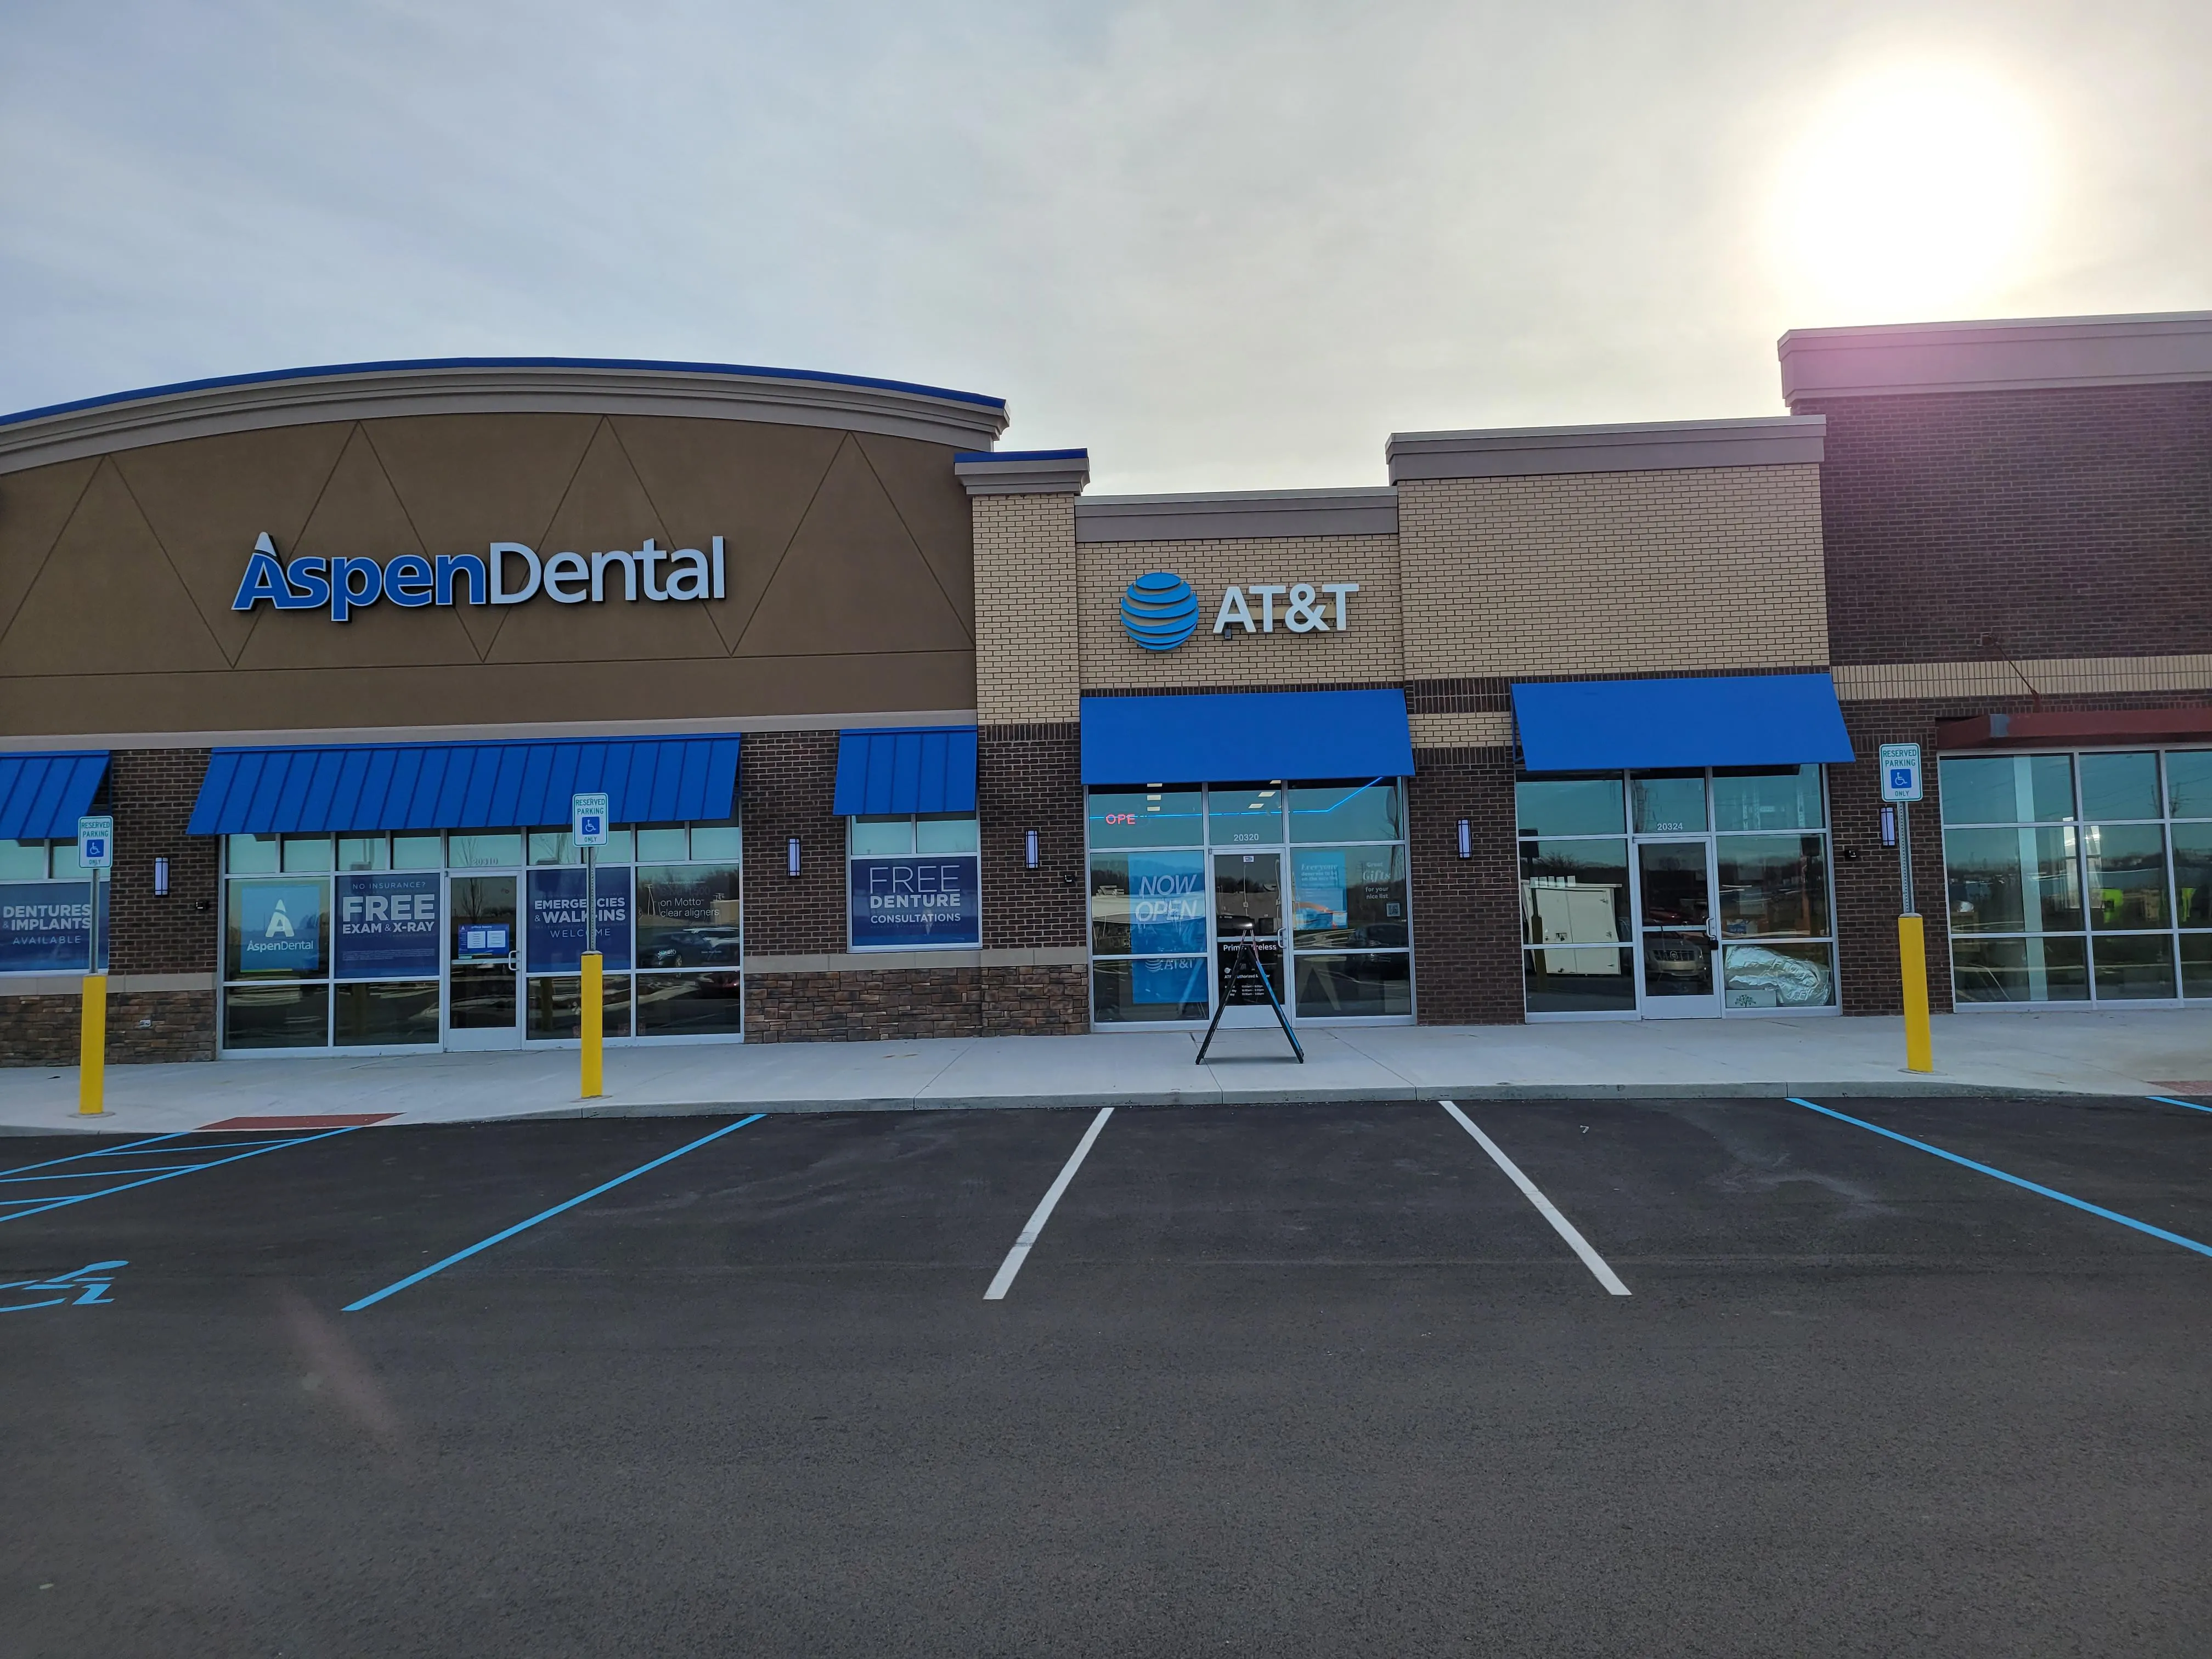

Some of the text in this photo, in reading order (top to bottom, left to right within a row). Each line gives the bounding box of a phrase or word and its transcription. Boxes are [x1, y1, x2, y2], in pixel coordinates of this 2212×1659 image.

[231, 531, 725, 622] AspenDental
[1212, 584, 1359, 634] AT&T
[1233, 833, 1259, 842] 20320
[472, 857, 498, 866] 20310
[870, 865, 960, 894] FREE
[1363, 871, 1391, 883] Gifts
[1139, 874, 1197, 895] NOW
[342, 894, 435, 922] FREE
[534, 897, 625, 910] EMERGECIES
[870, 894, 960, 909] DENTURE
[3, 904, 92, 918] DENTURES
[661, 908, 720, 918] clear aligners
[1135, 900, 1197, 922] OPEN
[11, 918, 91, 931] IMPLANTS
[870, 913, 961, 924] CONSULTATIONS
[342, 923, 382, 934] EXAM
[393, 921, 435, 933] X-RAY
[550, 928, 611, 938] WELCME
[13, 935, 81, 945] AVAILABLE
[247, 940, 313, 953] AspenDental
[1164, 958, 1194, 969] AT&T
